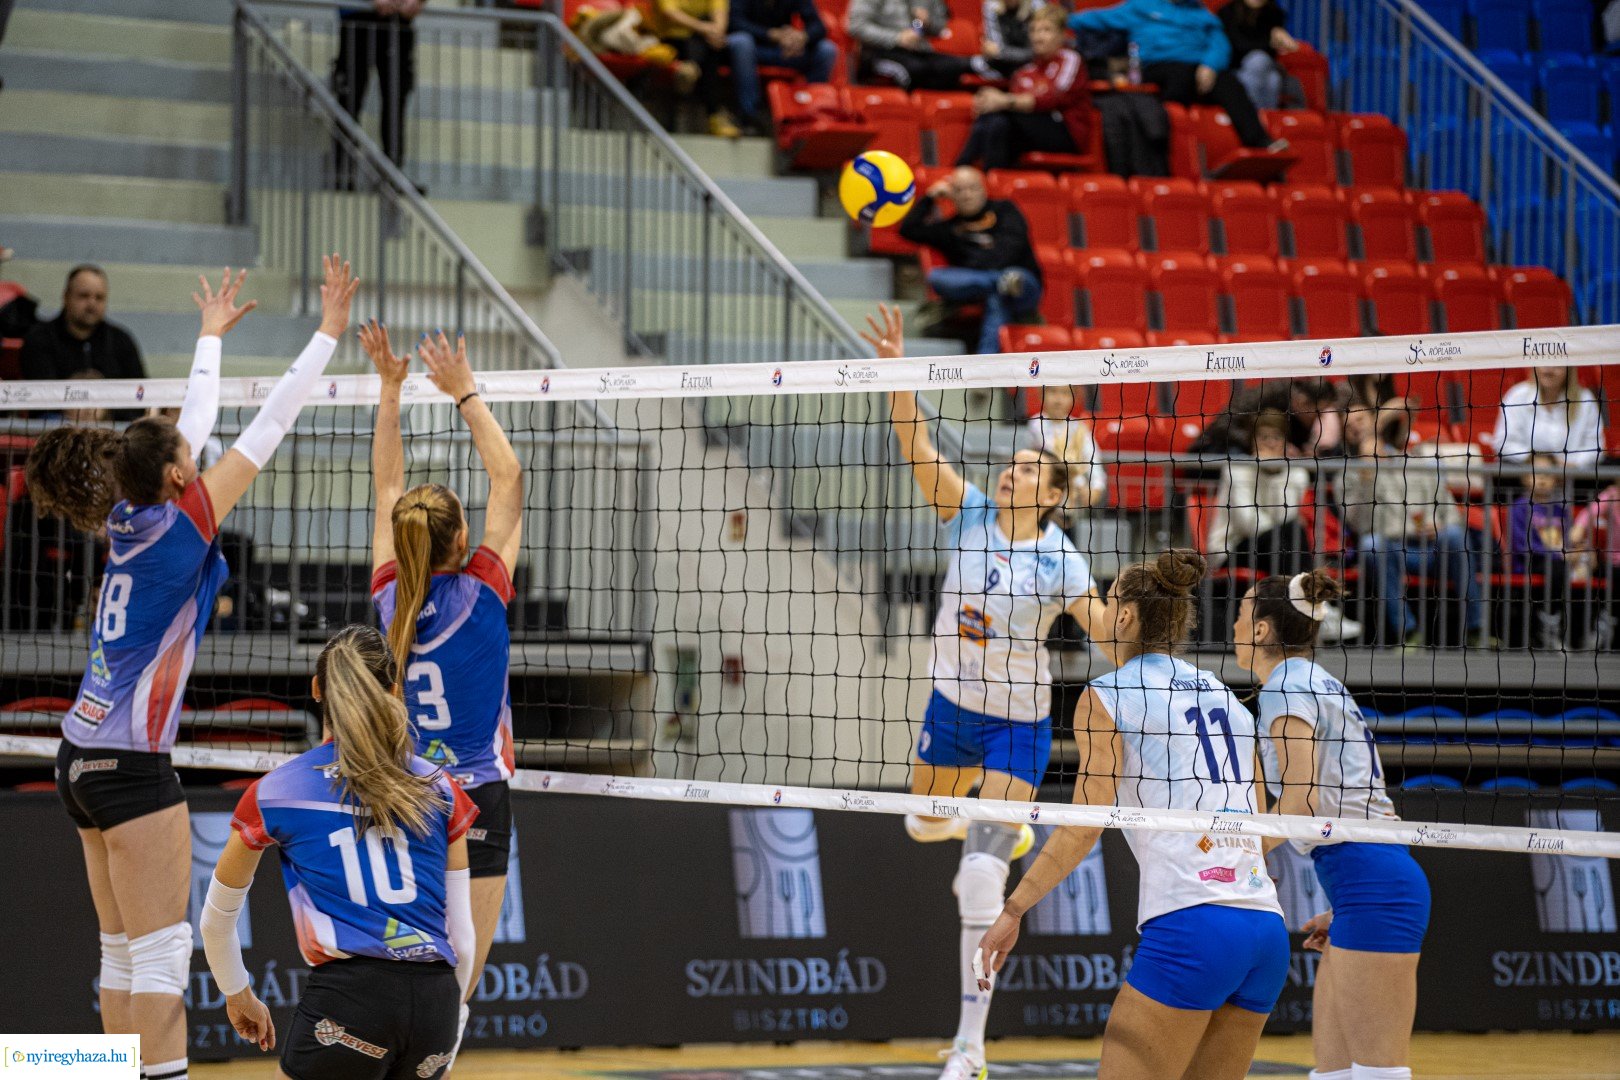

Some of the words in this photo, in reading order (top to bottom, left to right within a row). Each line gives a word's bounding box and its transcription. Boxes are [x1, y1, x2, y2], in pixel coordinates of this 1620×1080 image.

[1522, 336, 1569, 356] FATUM
[1205, 350, 1246, 370] FATUM
[680, 372, 712, 389] FATUM
[927, 363, 963, 381] FATUM
[405, 660, 452, 731] 3
[1184, 706, 1242, 785] 11
[683, 783, 711, 799] FATUM
[931, 799, 960, 817] FATUM
[1209, 815, 1243, 833] FATUM
[1526, 831, 1565, 851] FATUM
[328, 825, 418, 907] 10
[476, 953, 590, 1001] DBÁD
[685, 948, 887, 998] SZINDBÁD
[1492, 950, 1620, 987] SZINDB
[733, 1003, 849, 1032] BISZTRÓ
